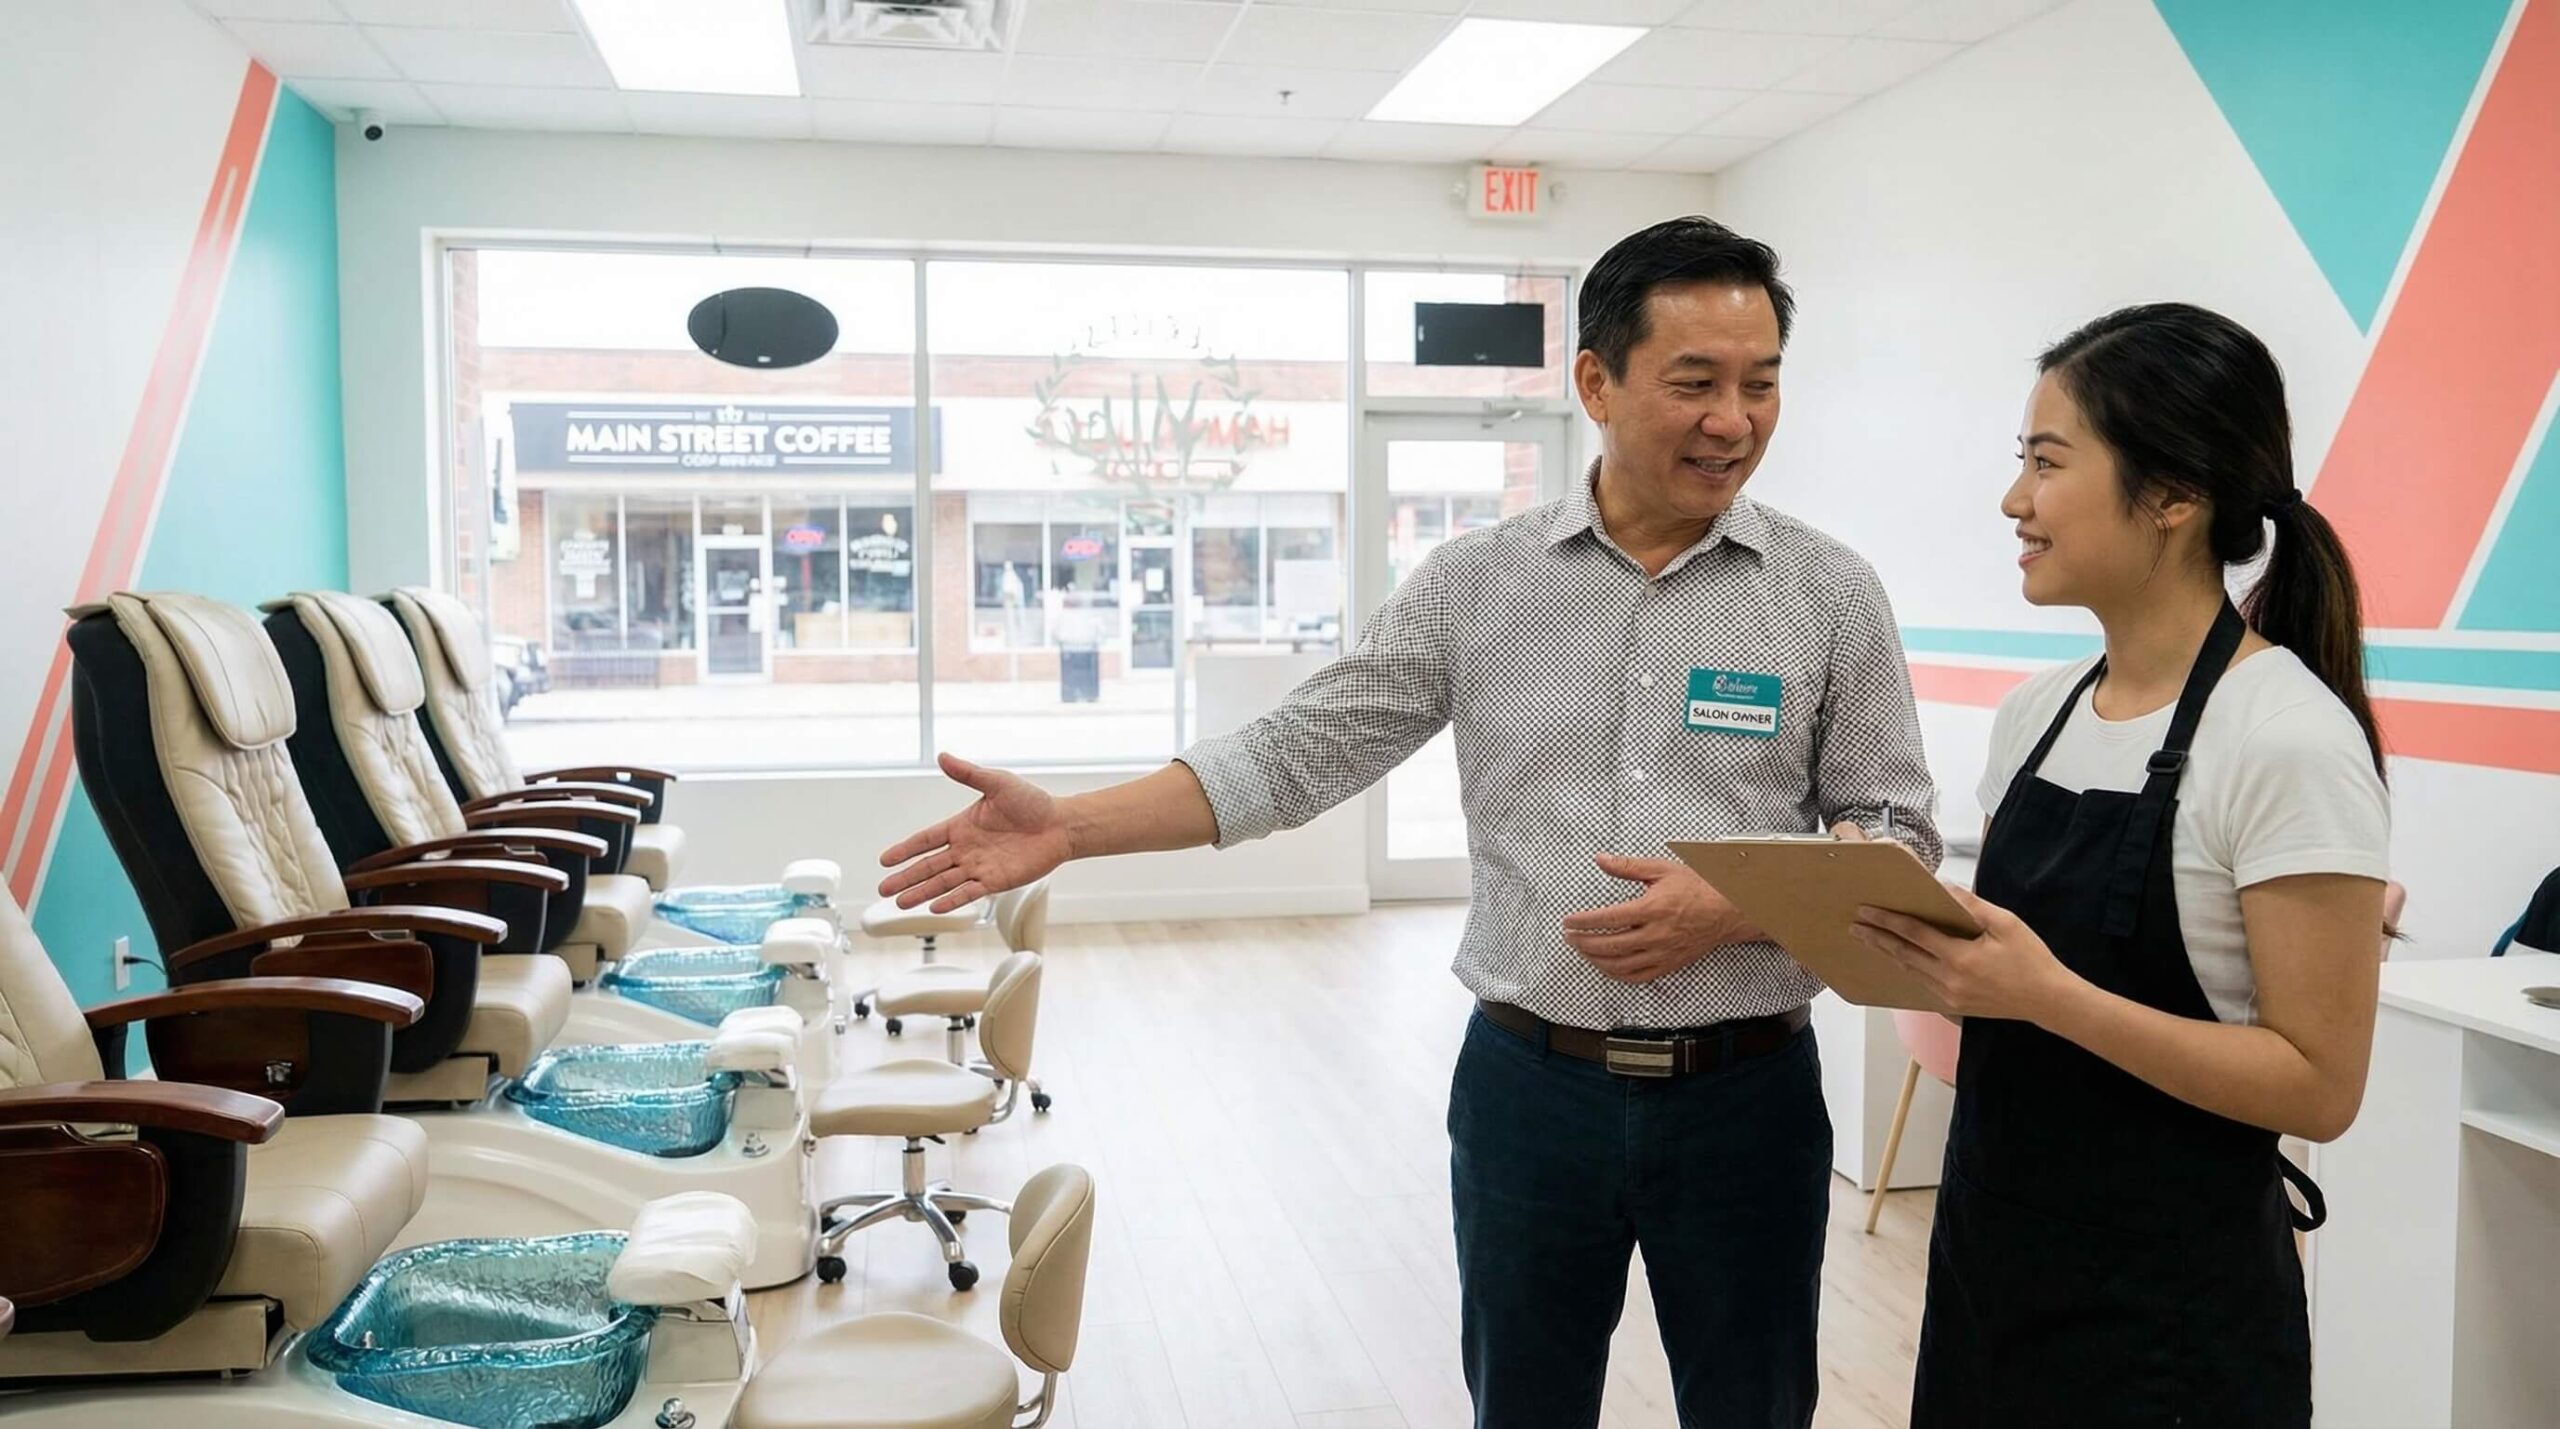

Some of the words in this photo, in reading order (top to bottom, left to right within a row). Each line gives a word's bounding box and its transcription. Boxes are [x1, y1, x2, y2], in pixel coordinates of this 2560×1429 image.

[1485, 170, 1538, 212] EXIT
[566, 423, 652, 453] MAIN
[657, 424, 769, 453] STREET
[774, 425, 892, 454] COFFEE
[1693, 707, 1729, 720] SALON
[1731, 712, 1772, 724] OWNER
